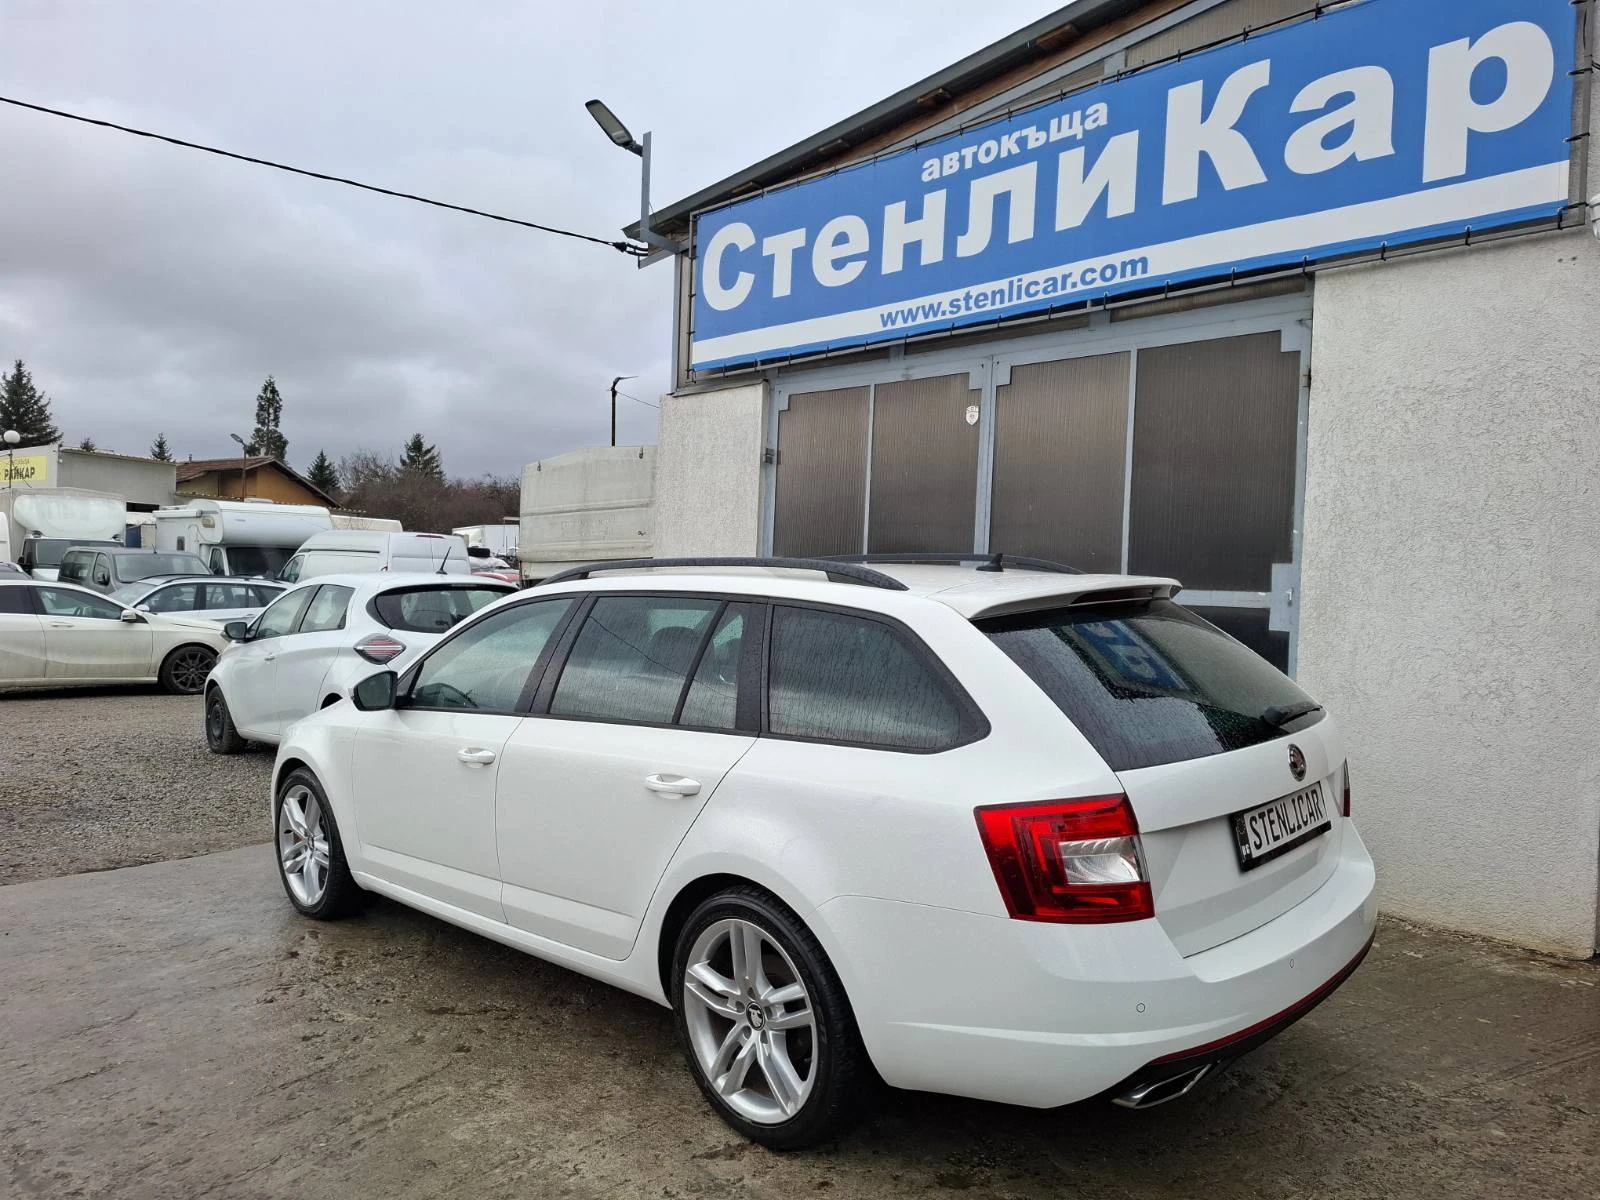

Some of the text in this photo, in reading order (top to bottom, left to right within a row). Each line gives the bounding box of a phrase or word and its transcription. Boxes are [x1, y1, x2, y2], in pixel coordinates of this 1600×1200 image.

[702, 21, 1554, 312] СтенлиКар
[921, 102, 1109, 183] автокъща
[879, 250, 1149, 330] www.stenlicar.com
[1249, 789, 1323, 851] STENLICAR
